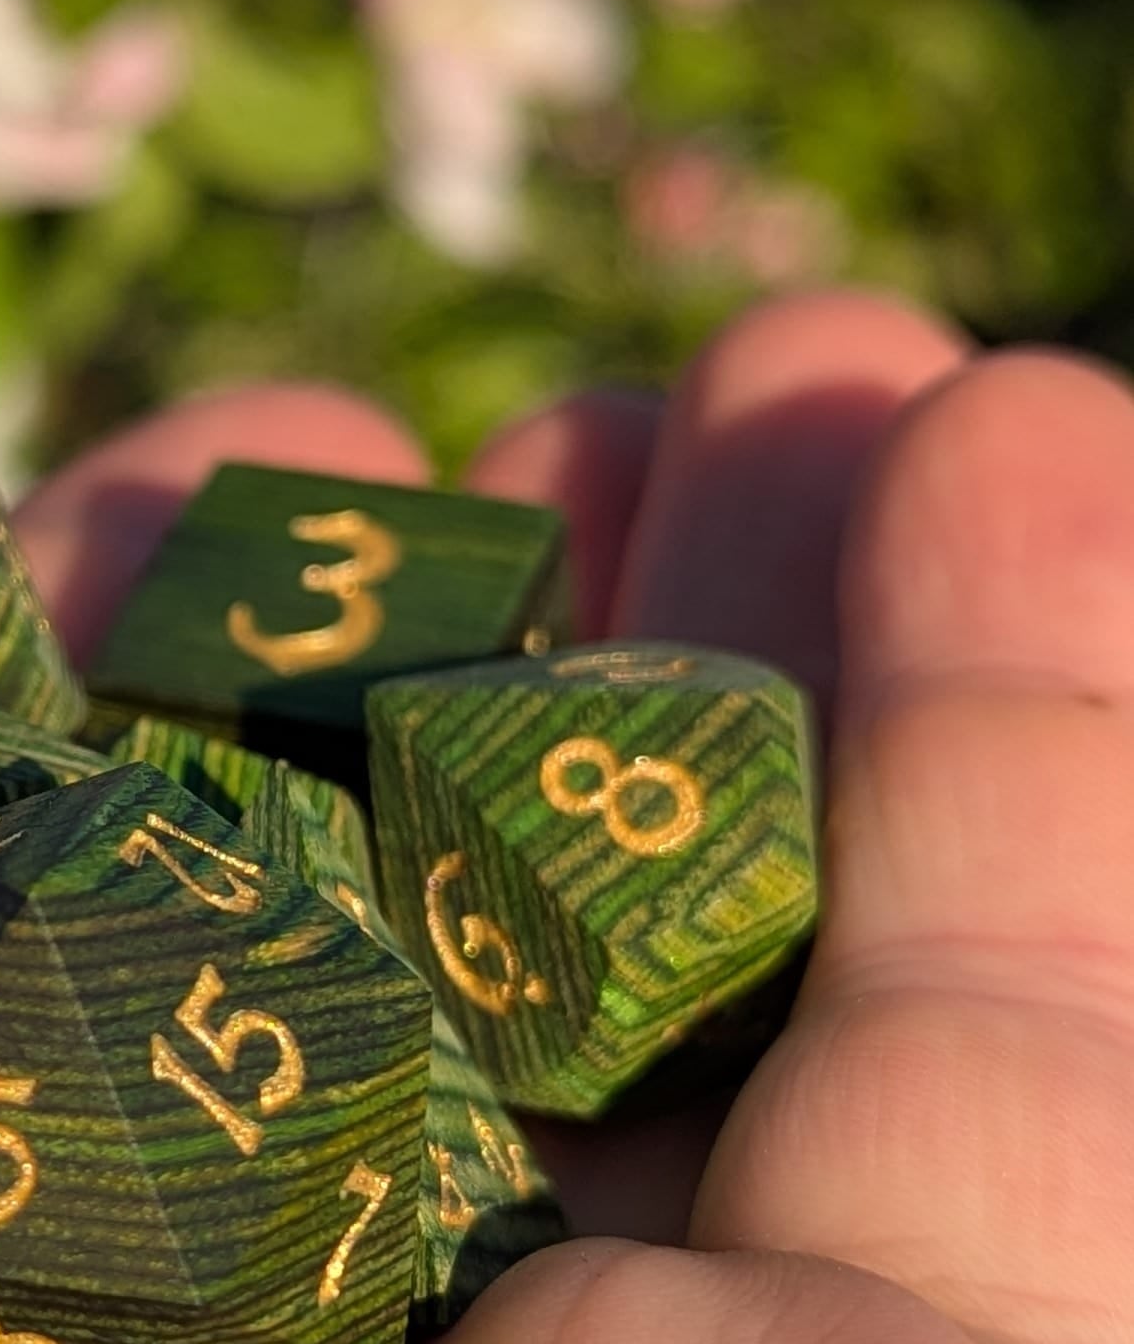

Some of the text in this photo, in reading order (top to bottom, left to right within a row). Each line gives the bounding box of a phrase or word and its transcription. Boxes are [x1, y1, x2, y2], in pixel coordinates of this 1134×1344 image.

[226, 509, 403, 676] 3
[540, 736, 707, 856] 8
[150, 962, 306, 1156] 15
[318, 1161, 393, 1307] 7
